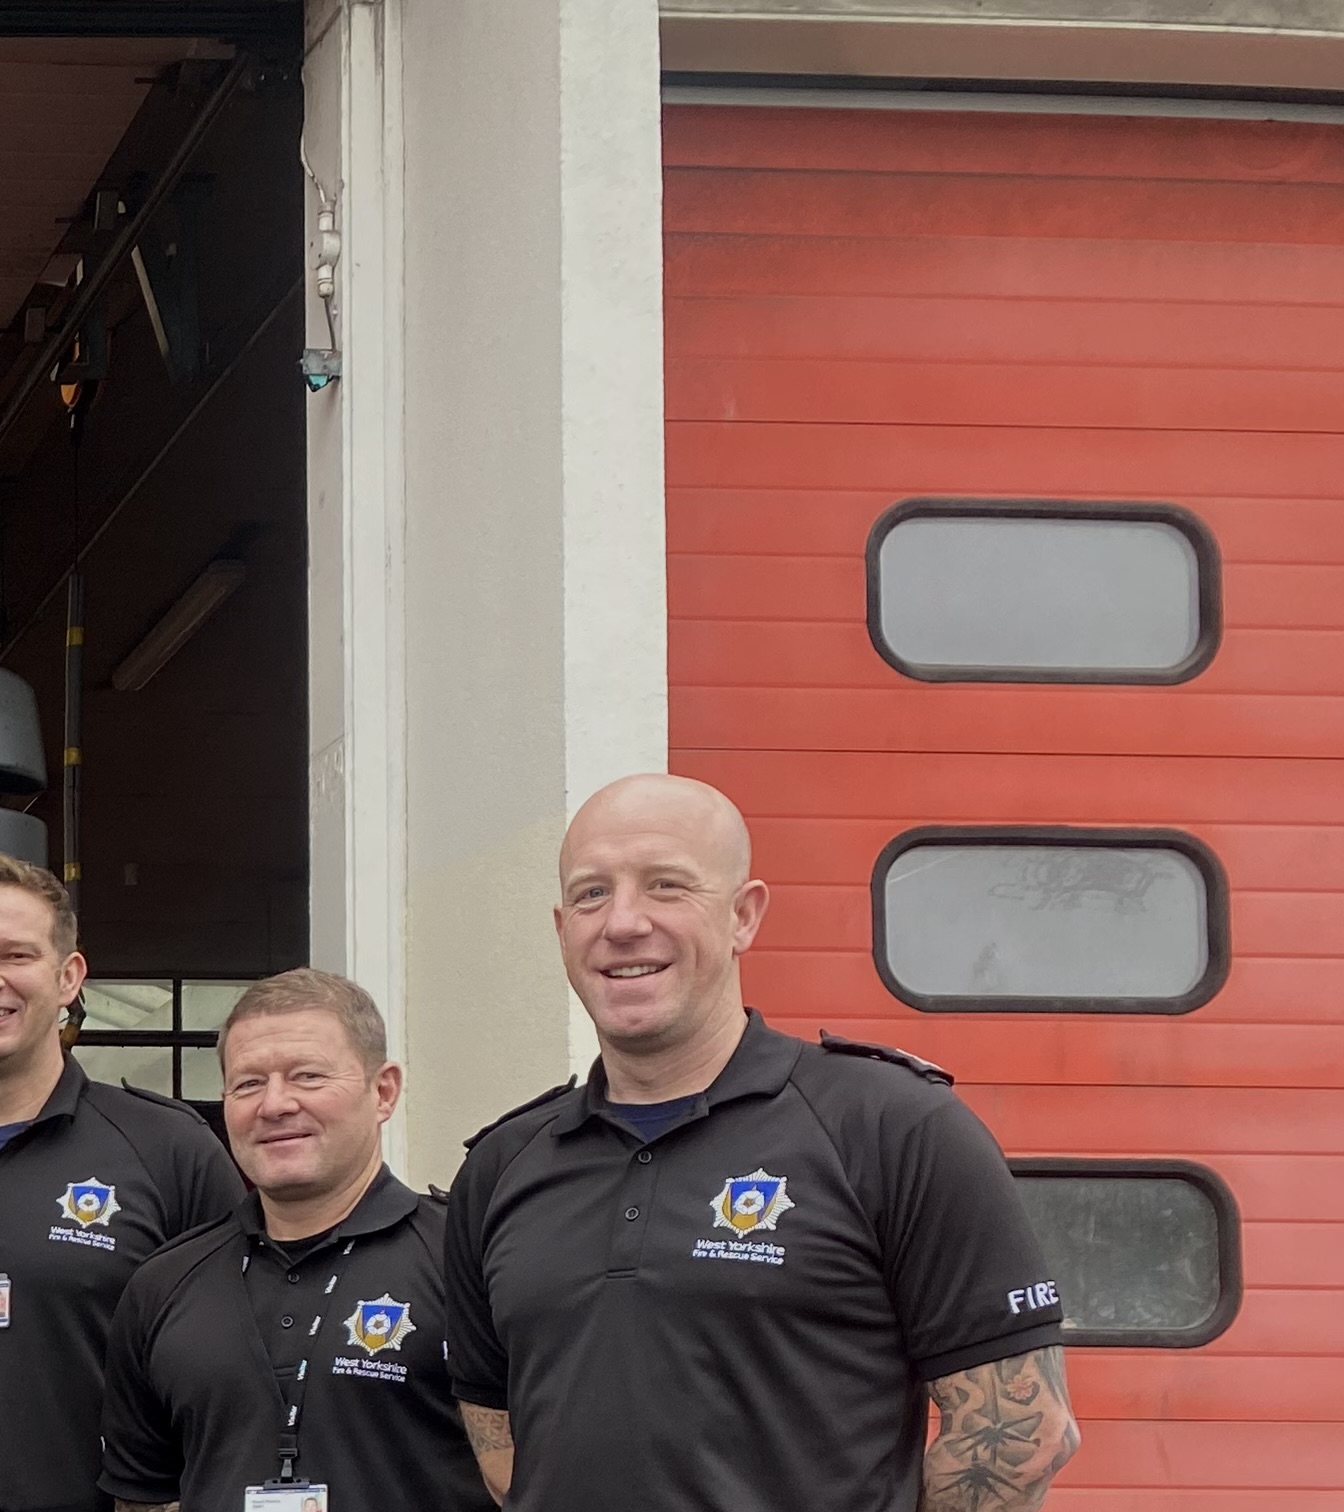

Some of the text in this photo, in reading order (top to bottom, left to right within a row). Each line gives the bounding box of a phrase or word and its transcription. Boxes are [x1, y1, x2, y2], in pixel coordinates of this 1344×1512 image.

[697, 1239, 786, 1256] West Yorkshire
[708, 1249, 716, 1258] &
[717, 1250, 749, 1260] Rescue
[750, 1253, 784, 1265] Service
[1007, 1281, 1059, 1314] FIRE
[335, 1357, 407, 1375] West Yorkshire
